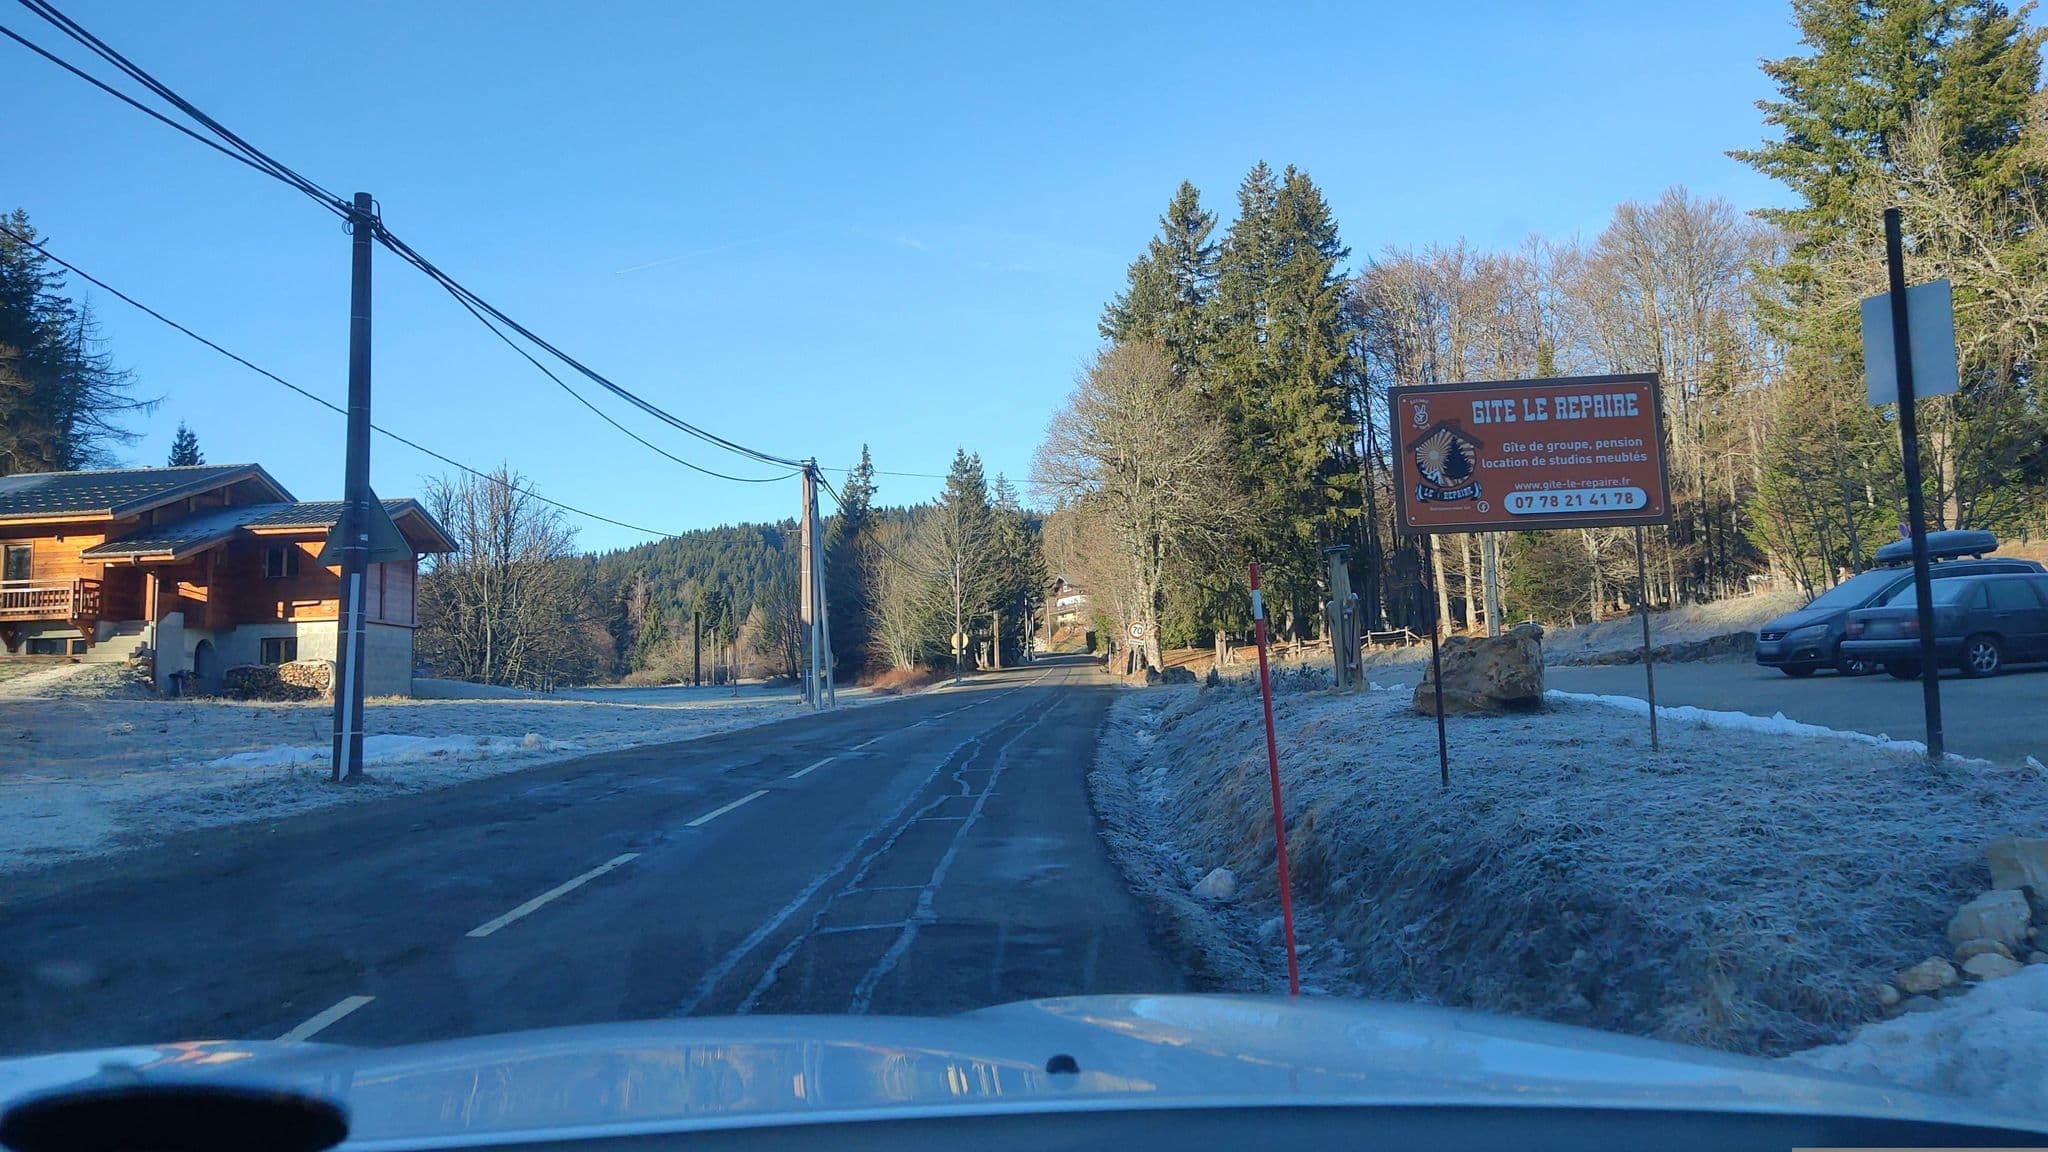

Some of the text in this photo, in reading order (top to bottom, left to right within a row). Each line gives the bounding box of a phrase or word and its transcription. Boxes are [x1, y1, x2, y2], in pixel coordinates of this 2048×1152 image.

[1472, 392, 1639, 424] GITE LE REPAIRE
[1503, 436, 1643, 453] Gîte de groupe, pension
[1482, 450, 1648, 469] location de studios meublés
[1515, 477, 1632, 490] www.gite-le-repaire.fr
[1515, 492, 1634, 509] 07 78 21 41 78
[1133, 626, 1142, 634] 70
